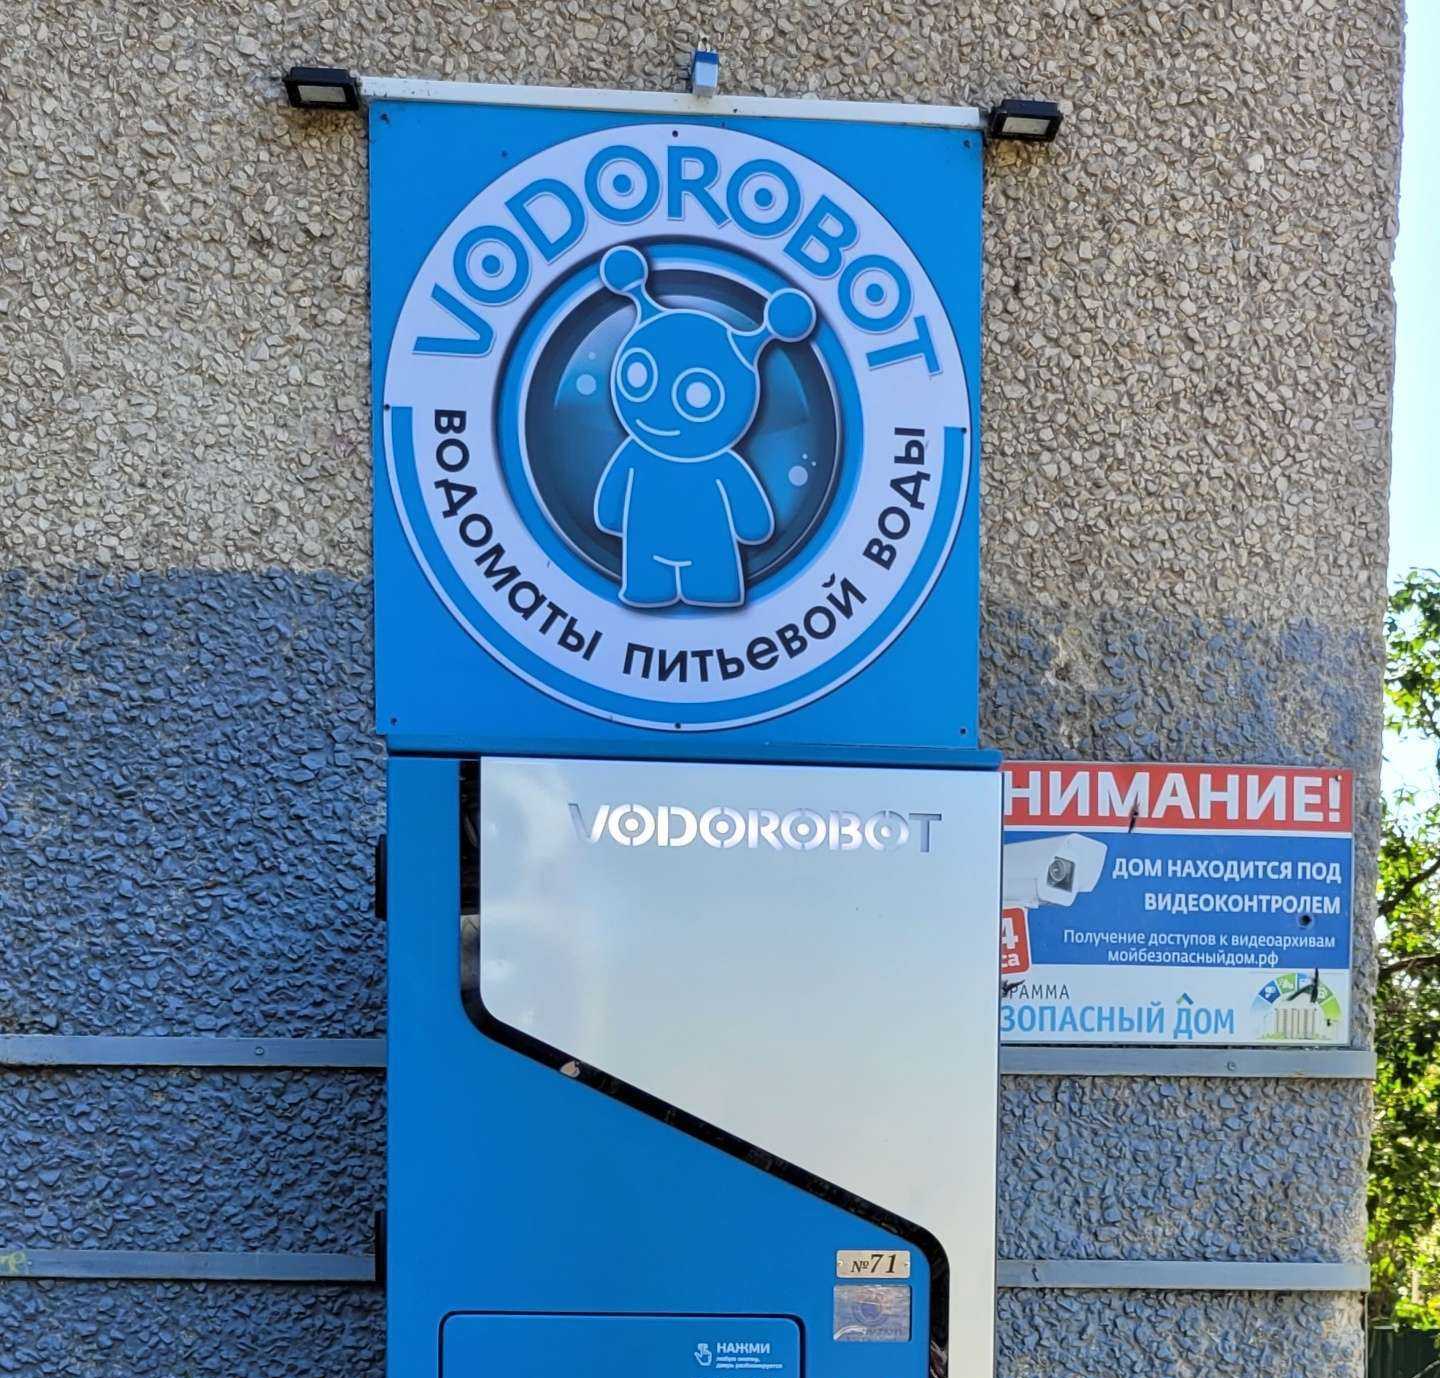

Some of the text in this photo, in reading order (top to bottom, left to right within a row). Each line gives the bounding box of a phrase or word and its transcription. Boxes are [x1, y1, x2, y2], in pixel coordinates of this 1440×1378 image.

[412, 144, 943, 377] VODOROBOT
[567, 802, 943, 854] VODOROBOT
[1112, 857, 1342, 884] ДОМ НАХОДИТСЯ ПОД
[1144, 892, 1341, 914] ВИДЕОКОНТРОЛЕМ
[1063, 929, 1336, 950] Получение доступов к видеоархивам
[1107, 949, 1279, 968] мойбезопасныйдом.рф
[1173, 1007, 1235, 1039] ДОМ
[716, 1342, 770, 1354] НАЖМИ
